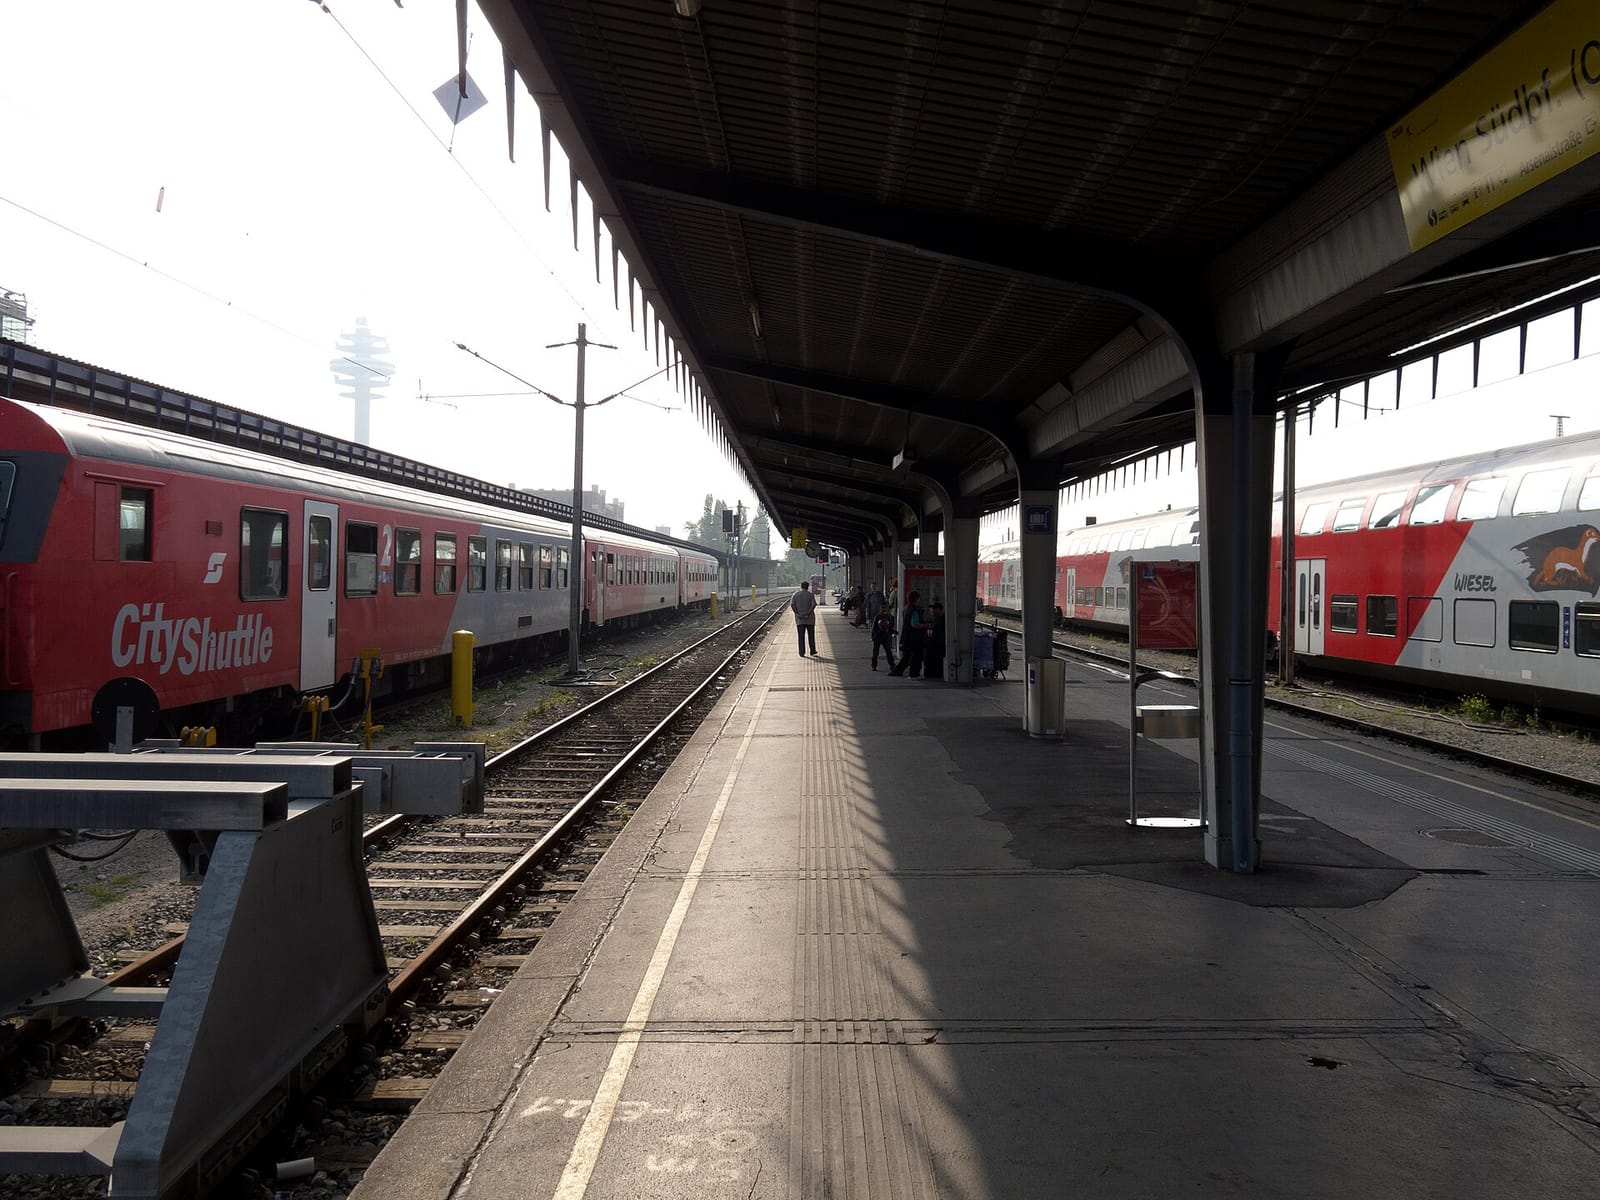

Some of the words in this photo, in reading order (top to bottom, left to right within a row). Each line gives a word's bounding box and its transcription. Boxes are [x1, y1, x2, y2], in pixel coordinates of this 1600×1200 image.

[1411, 139, 1472, 190] Wien
[381, 524, 393, 566] 2
[1454, 572, 1497, 592] WIESEL
[111, 602, 273, 676] CityShuttle
